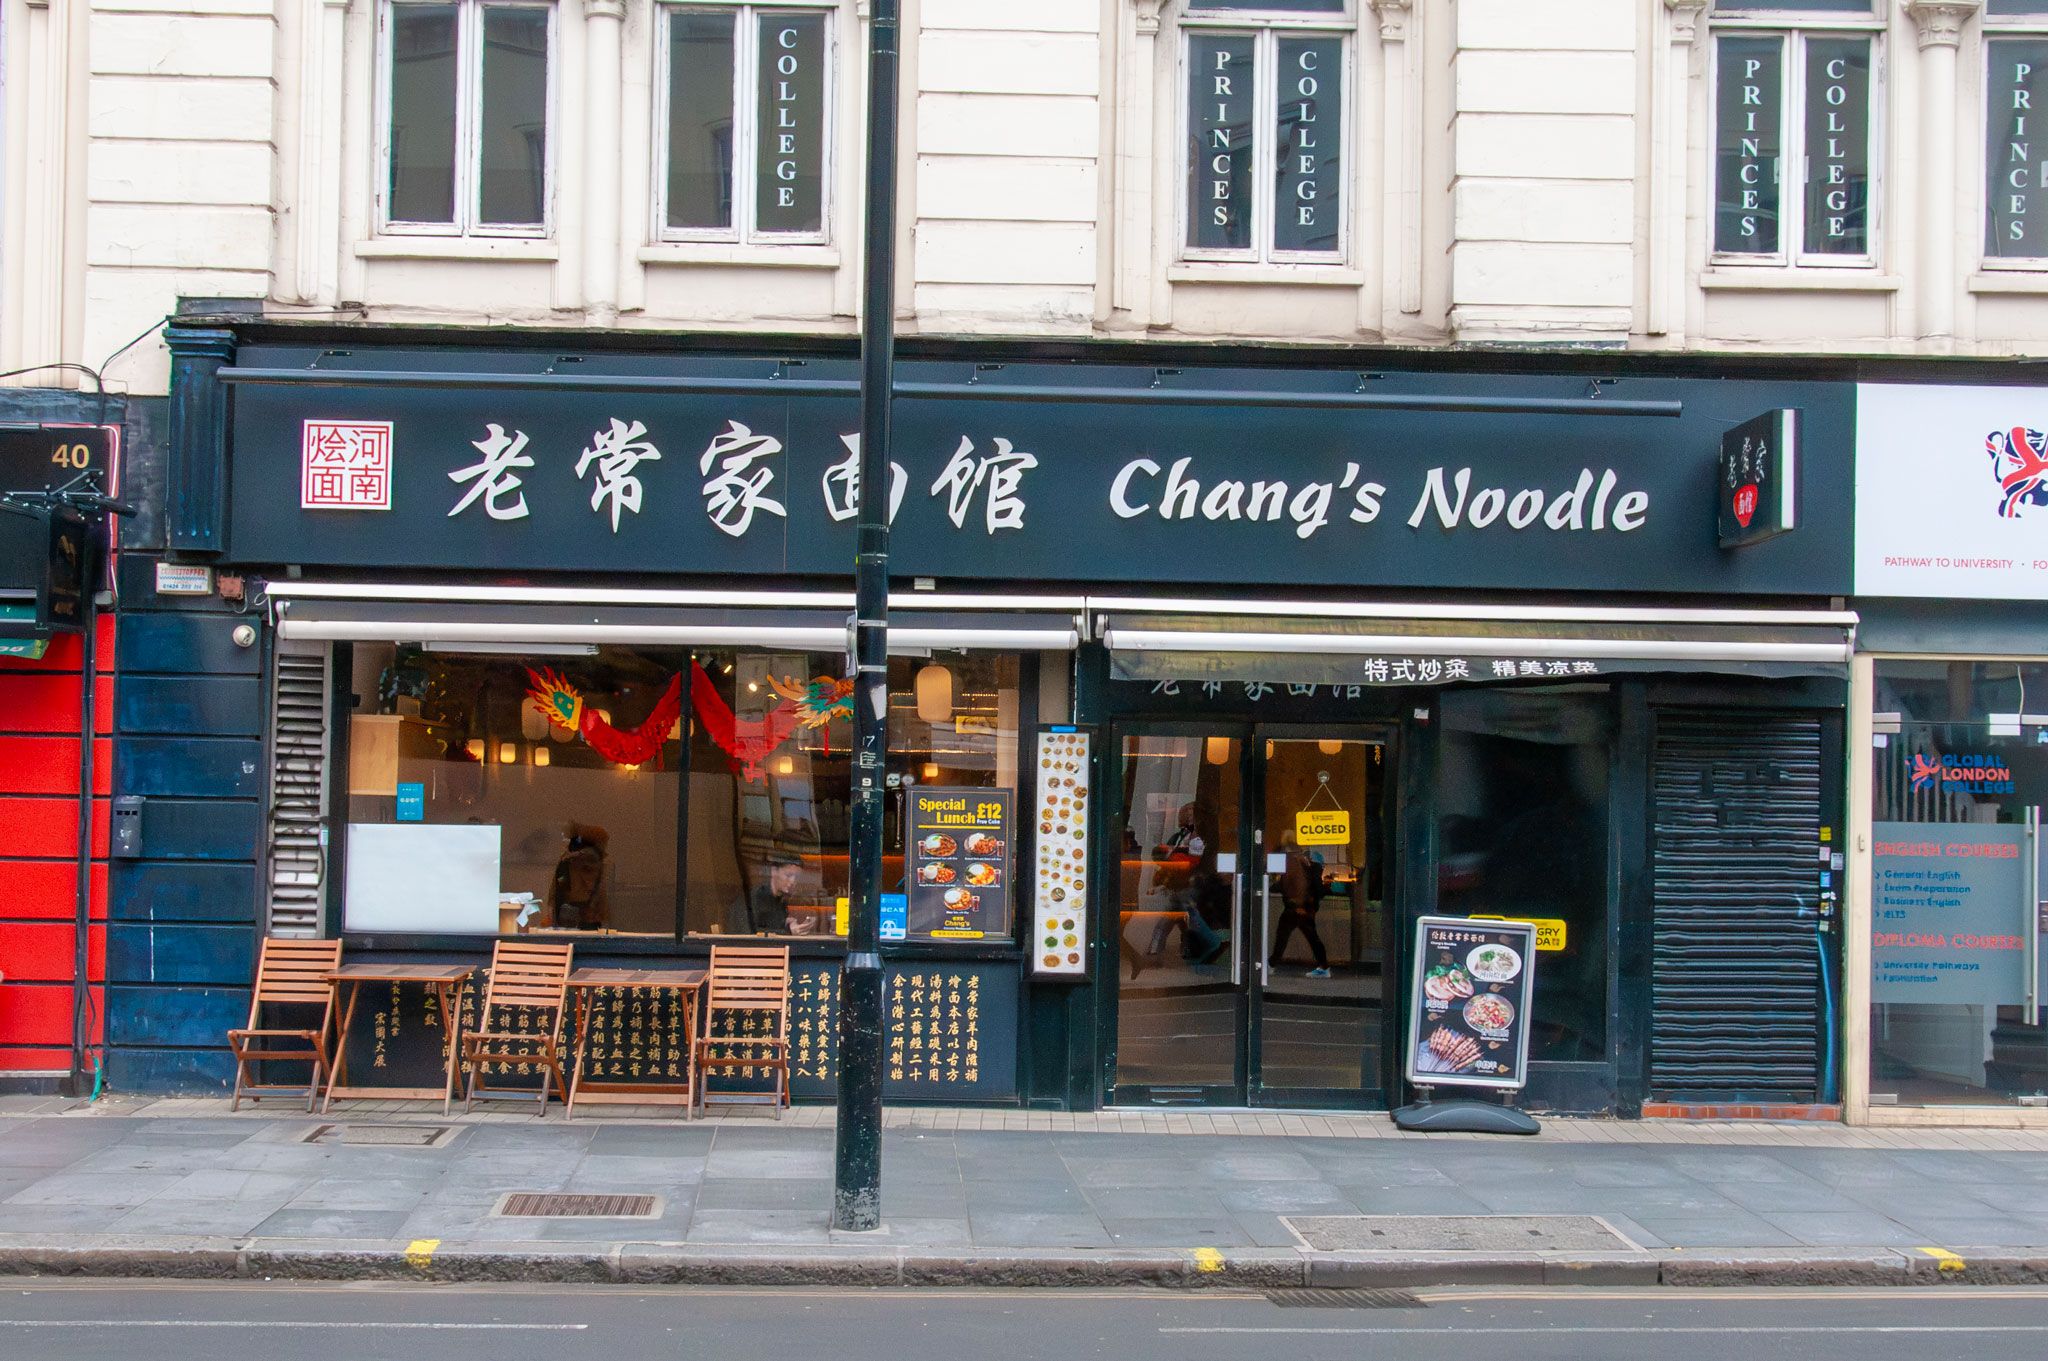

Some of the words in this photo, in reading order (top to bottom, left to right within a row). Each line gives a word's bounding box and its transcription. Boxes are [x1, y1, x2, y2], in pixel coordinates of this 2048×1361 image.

[777, 28, 798, 207] COLLEGE
[1212, 51, 1232, 226] PRINCES
[1297, 51, 1317, 225] COLLEGE
[1740, 59, 1762, 236] PRINCES
[1826, 59, 1847, 237] COLLEGE
[2009, 63, 2031, 240] PRINCES
[52, 444, 90, 469] 40
[447, 417, 1038, 537] 老常家面馆
[1108, 456, 1387, 539] Chang's
[1406, 467, 1649, 533] Noodle
[1884, 556, 1932, 567] PATHWAY
[1935, 557, 1950, 568] TO
[1953, 558, 2014, 569] UNIVERSITY
[1364, 657, 1470, 682] 特式炒菜
[1942, 754, 2005, 767] GLOBAL
[1942, 767, 2010, 781] LONDON
[1942, 781, 2015, 794] COLLEGE
[918, 797, 966, 812] Special
[976, 802, 1002, 819] £12
[936, 811, 976, 824] Lunch
[1300, 824, 1346, 834] CLOSED
[1874, 841, 1941, 857] ENGLISH
[1945, 842, 2019, 858] COURSES
[1884, 870, 1924, 879] General
[1927, 870, 1961, 881] English
[1927, 897, 1961, 908] English
[1536, 927, 1560, 936] GRY
[1873, 931, 1947, 948] DIPLOMA
[1951, 933, 2024, 950] COURSES
